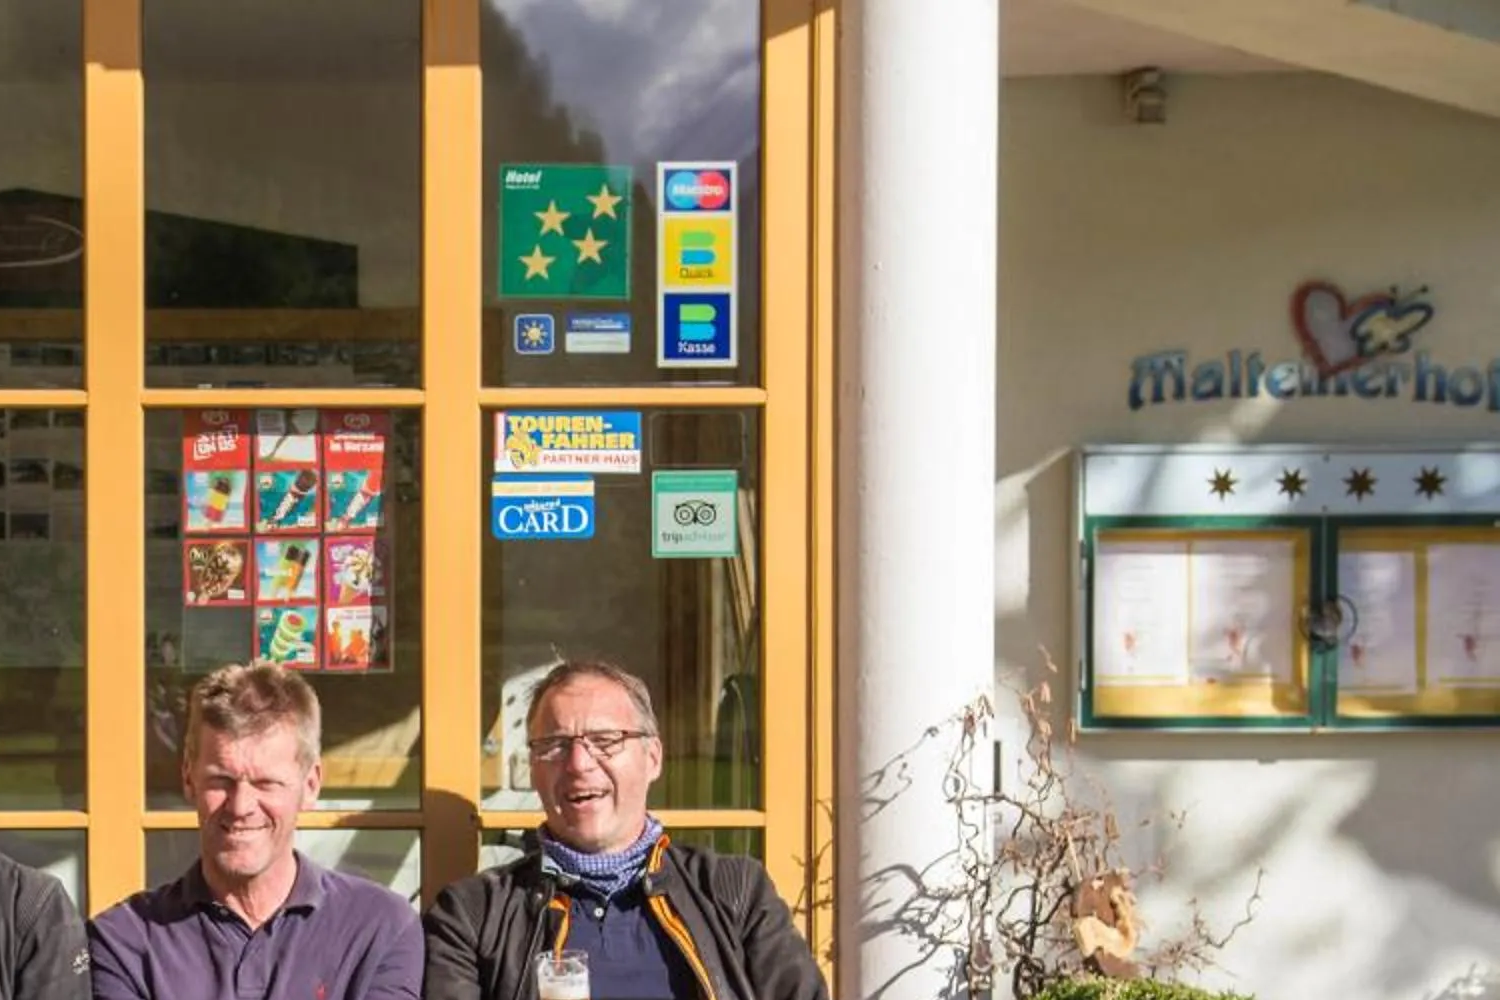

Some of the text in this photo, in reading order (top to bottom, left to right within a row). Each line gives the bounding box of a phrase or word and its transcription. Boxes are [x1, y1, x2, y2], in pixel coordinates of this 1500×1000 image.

[505, 170, 543, 184] Hotel
[677, 342, 717, 354] Kasse
[506, 415, 613, 432] TOUREN-
[541, 432, 636, 450] FAHRER
[543, 453, 597, 465] PARTNER
[499, 504, 590, 534] CARD
